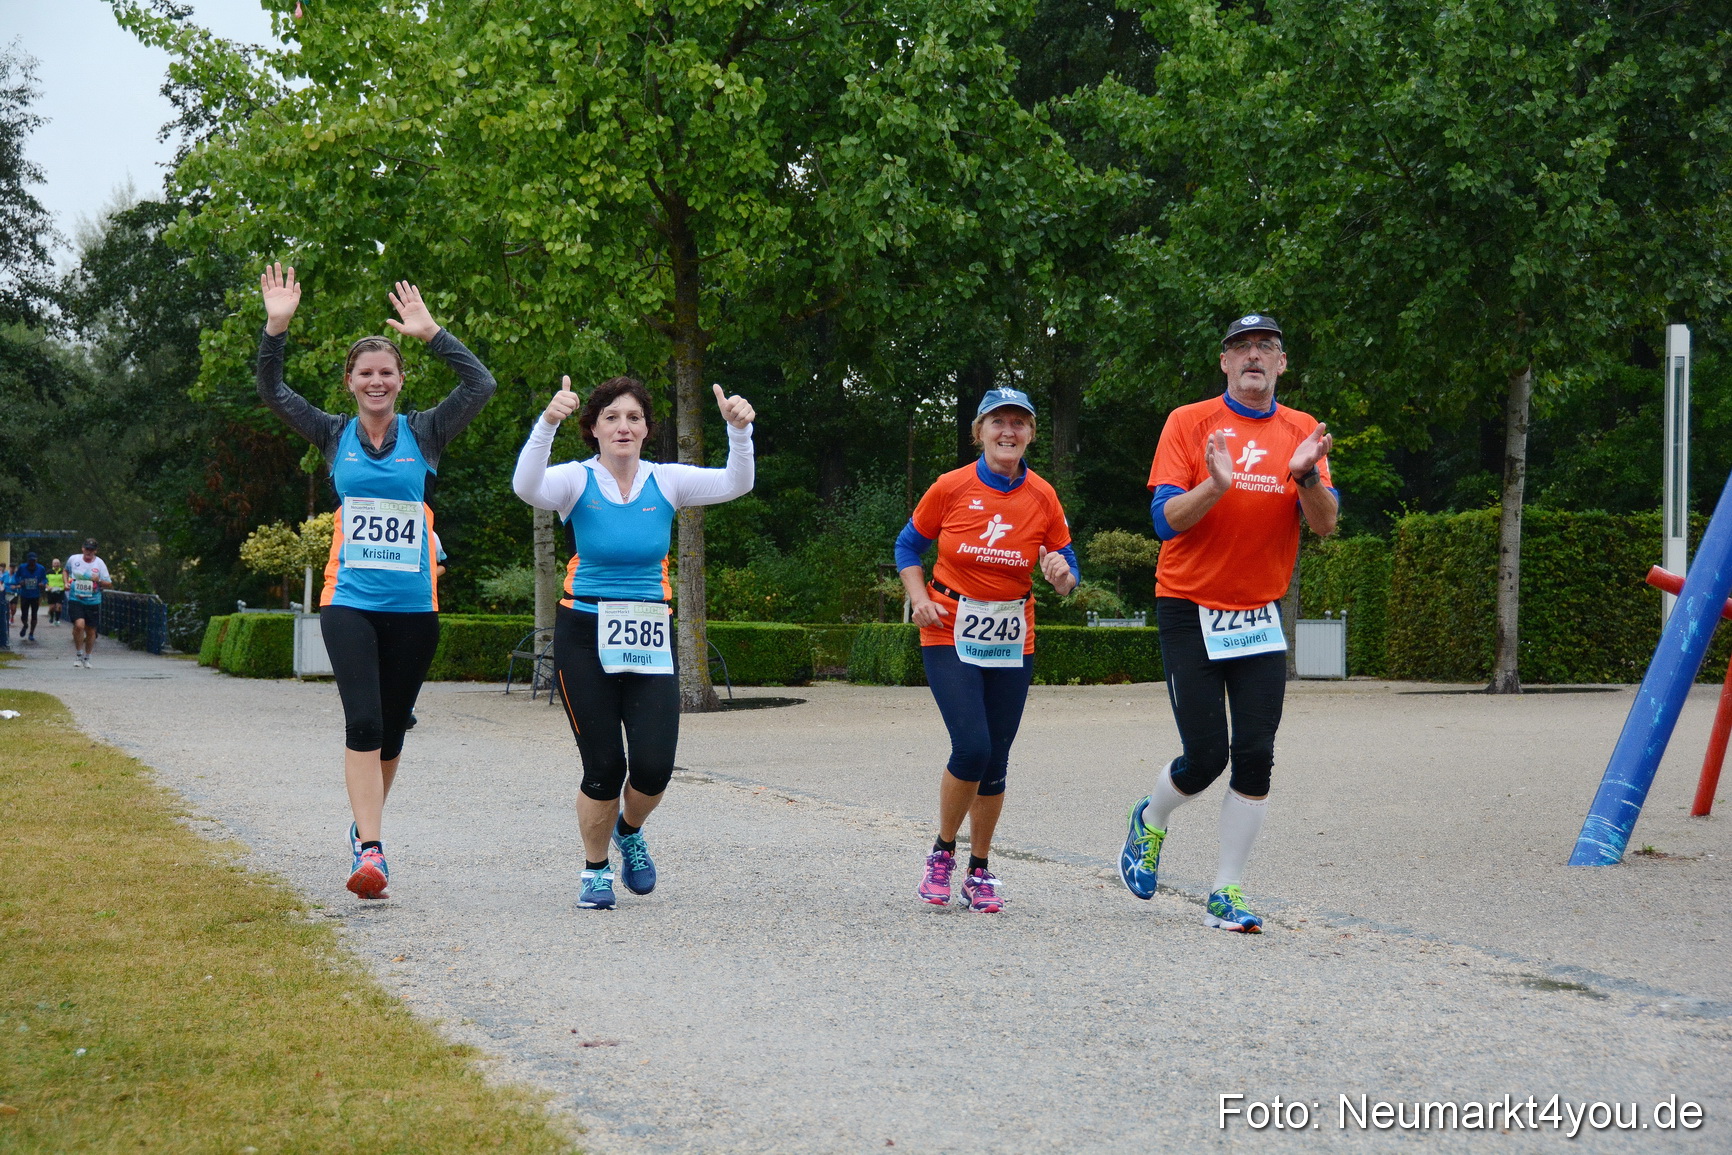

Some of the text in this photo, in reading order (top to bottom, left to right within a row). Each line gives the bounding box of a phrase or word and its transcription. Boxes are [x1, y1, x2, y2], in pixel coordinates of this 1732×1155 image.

[1231, 472, 1277, 484] nrunners
[1236, 481, 1285, 494] neumarkt
[379, 501, 418, 513] BOCK
[352, 515, 415, 544] 2584
[362, 547, 401, 561] Kristina
[957, 543, 1021, 559] funrunners
[975, 555, 1030, 567] neumarkt
[1208, 606, 1273, 632] 2244
[607, 619, 665, 648] 2585
[962, 614, 1021, 641] 2243
[1222, 632, 1268, 648] Siegfried
[965, 644, 1011, 657] Hannelore
[622, 652, 652, 665] Margit
